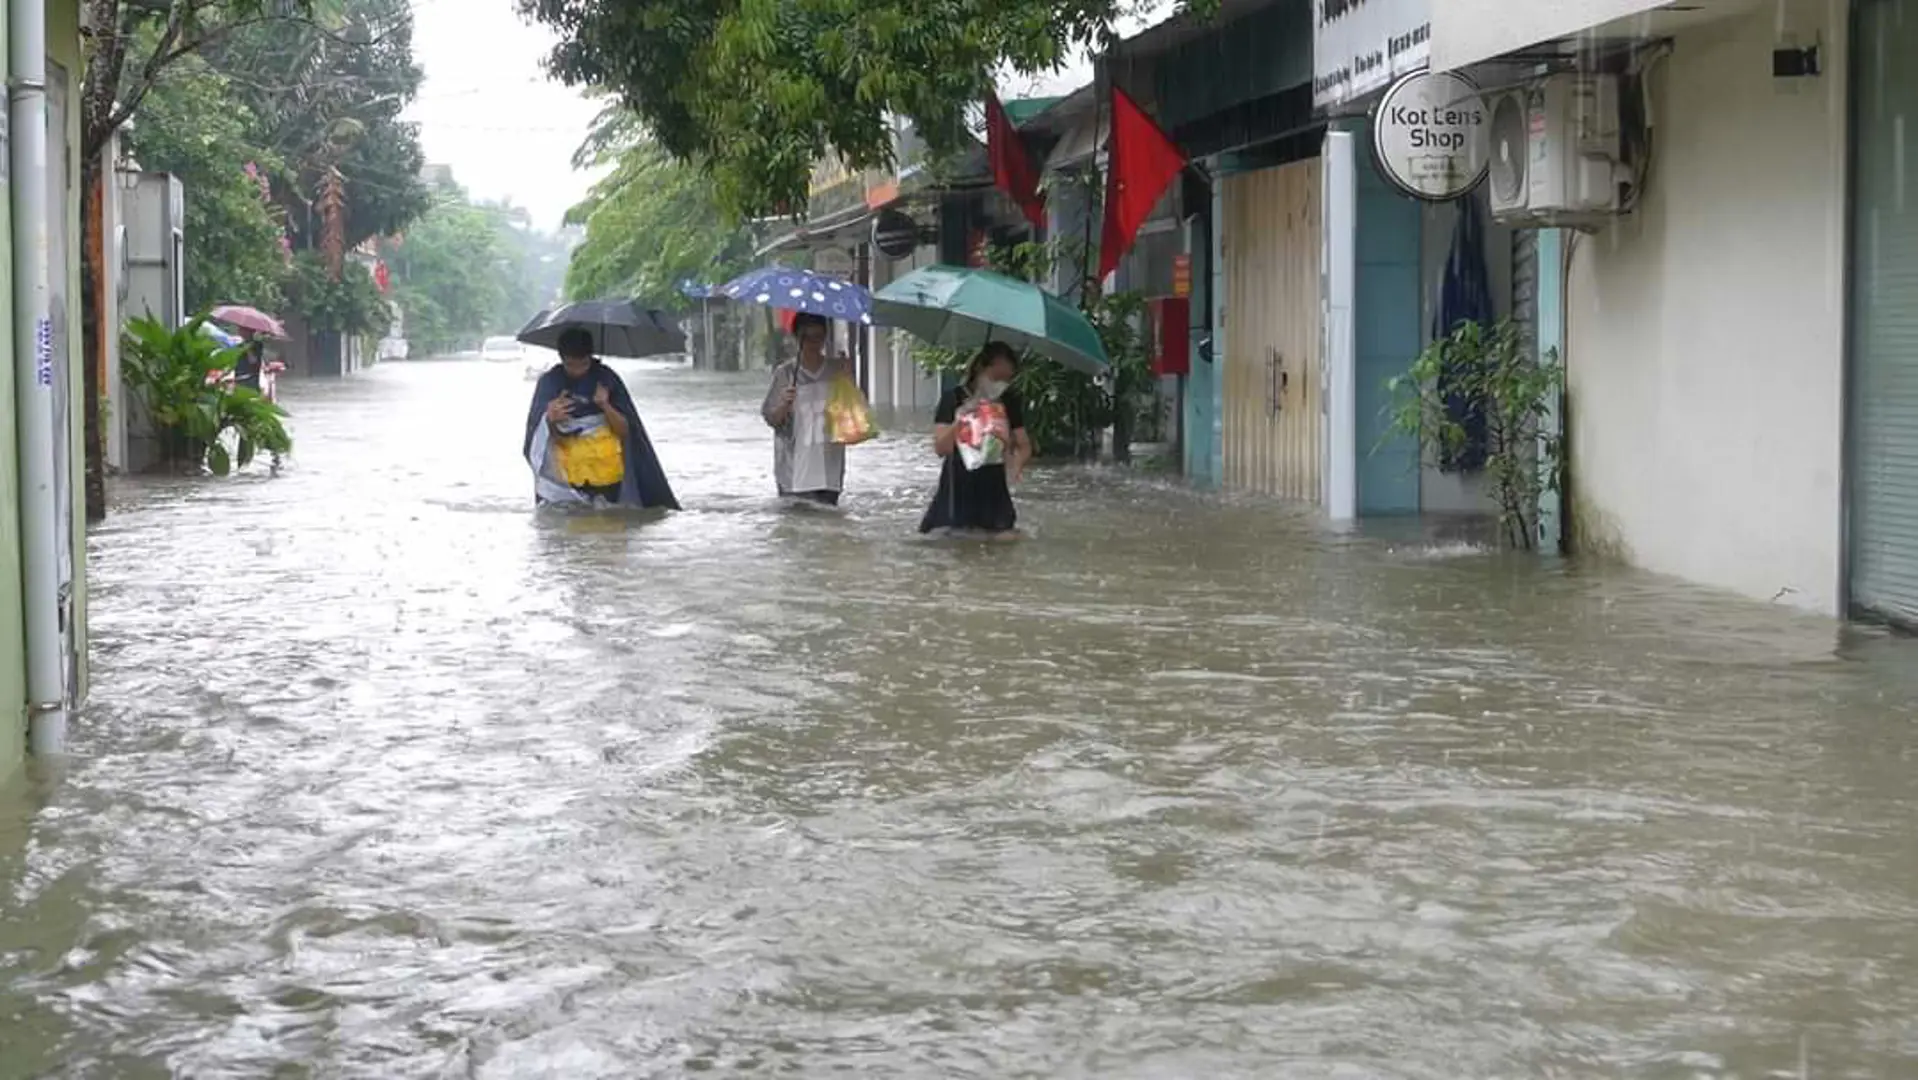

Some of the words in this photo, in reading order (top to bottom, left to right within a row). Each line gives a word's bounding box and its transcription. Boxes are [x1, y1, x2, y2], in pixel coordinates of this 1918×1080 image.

[1391, 106, 1428, 125] Kot
[1434, 106, 1482, 125] Lens
[1410, 128, 1464, 151] Shop
